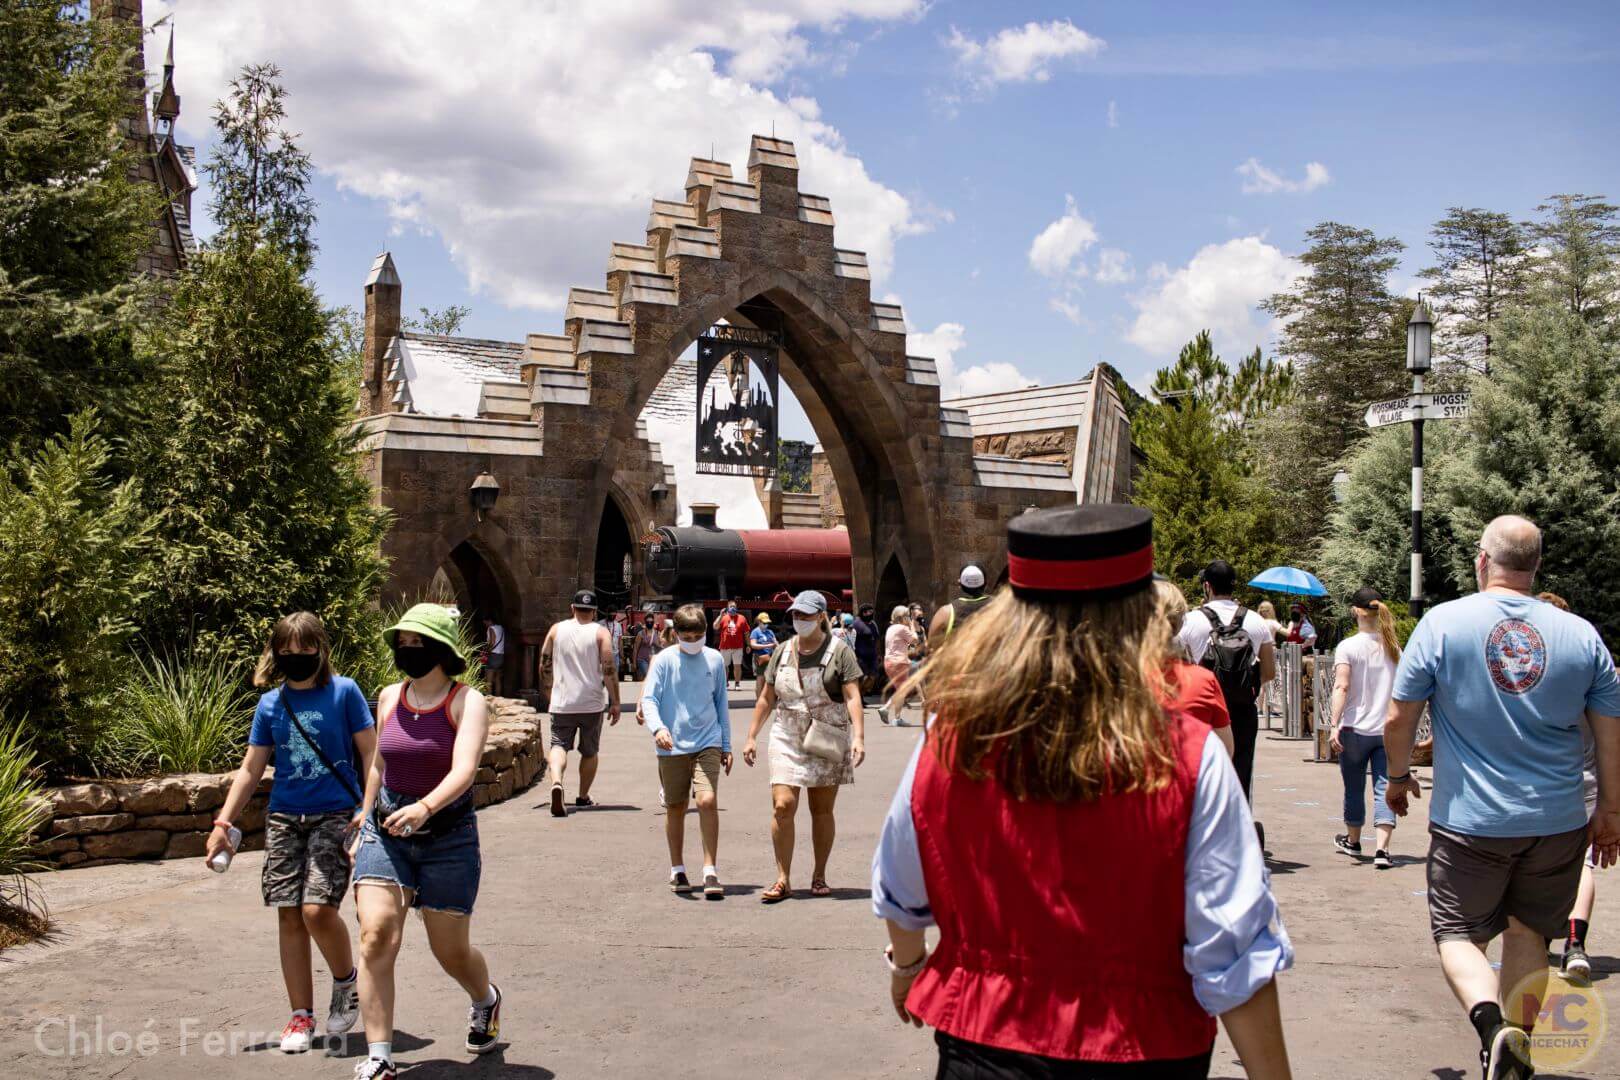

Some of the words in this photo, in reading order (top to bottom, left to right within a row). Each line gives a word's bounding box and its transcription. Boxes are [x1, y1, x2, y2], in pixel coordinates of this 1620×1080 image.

[1371, 398, 1409, 414] HOGSMEADE
[1432, 394, 1472, 406] HOGSM
[1443, 405, 1469, 417] STAT
[1378, 411, 1402, 424] VILLAGE
